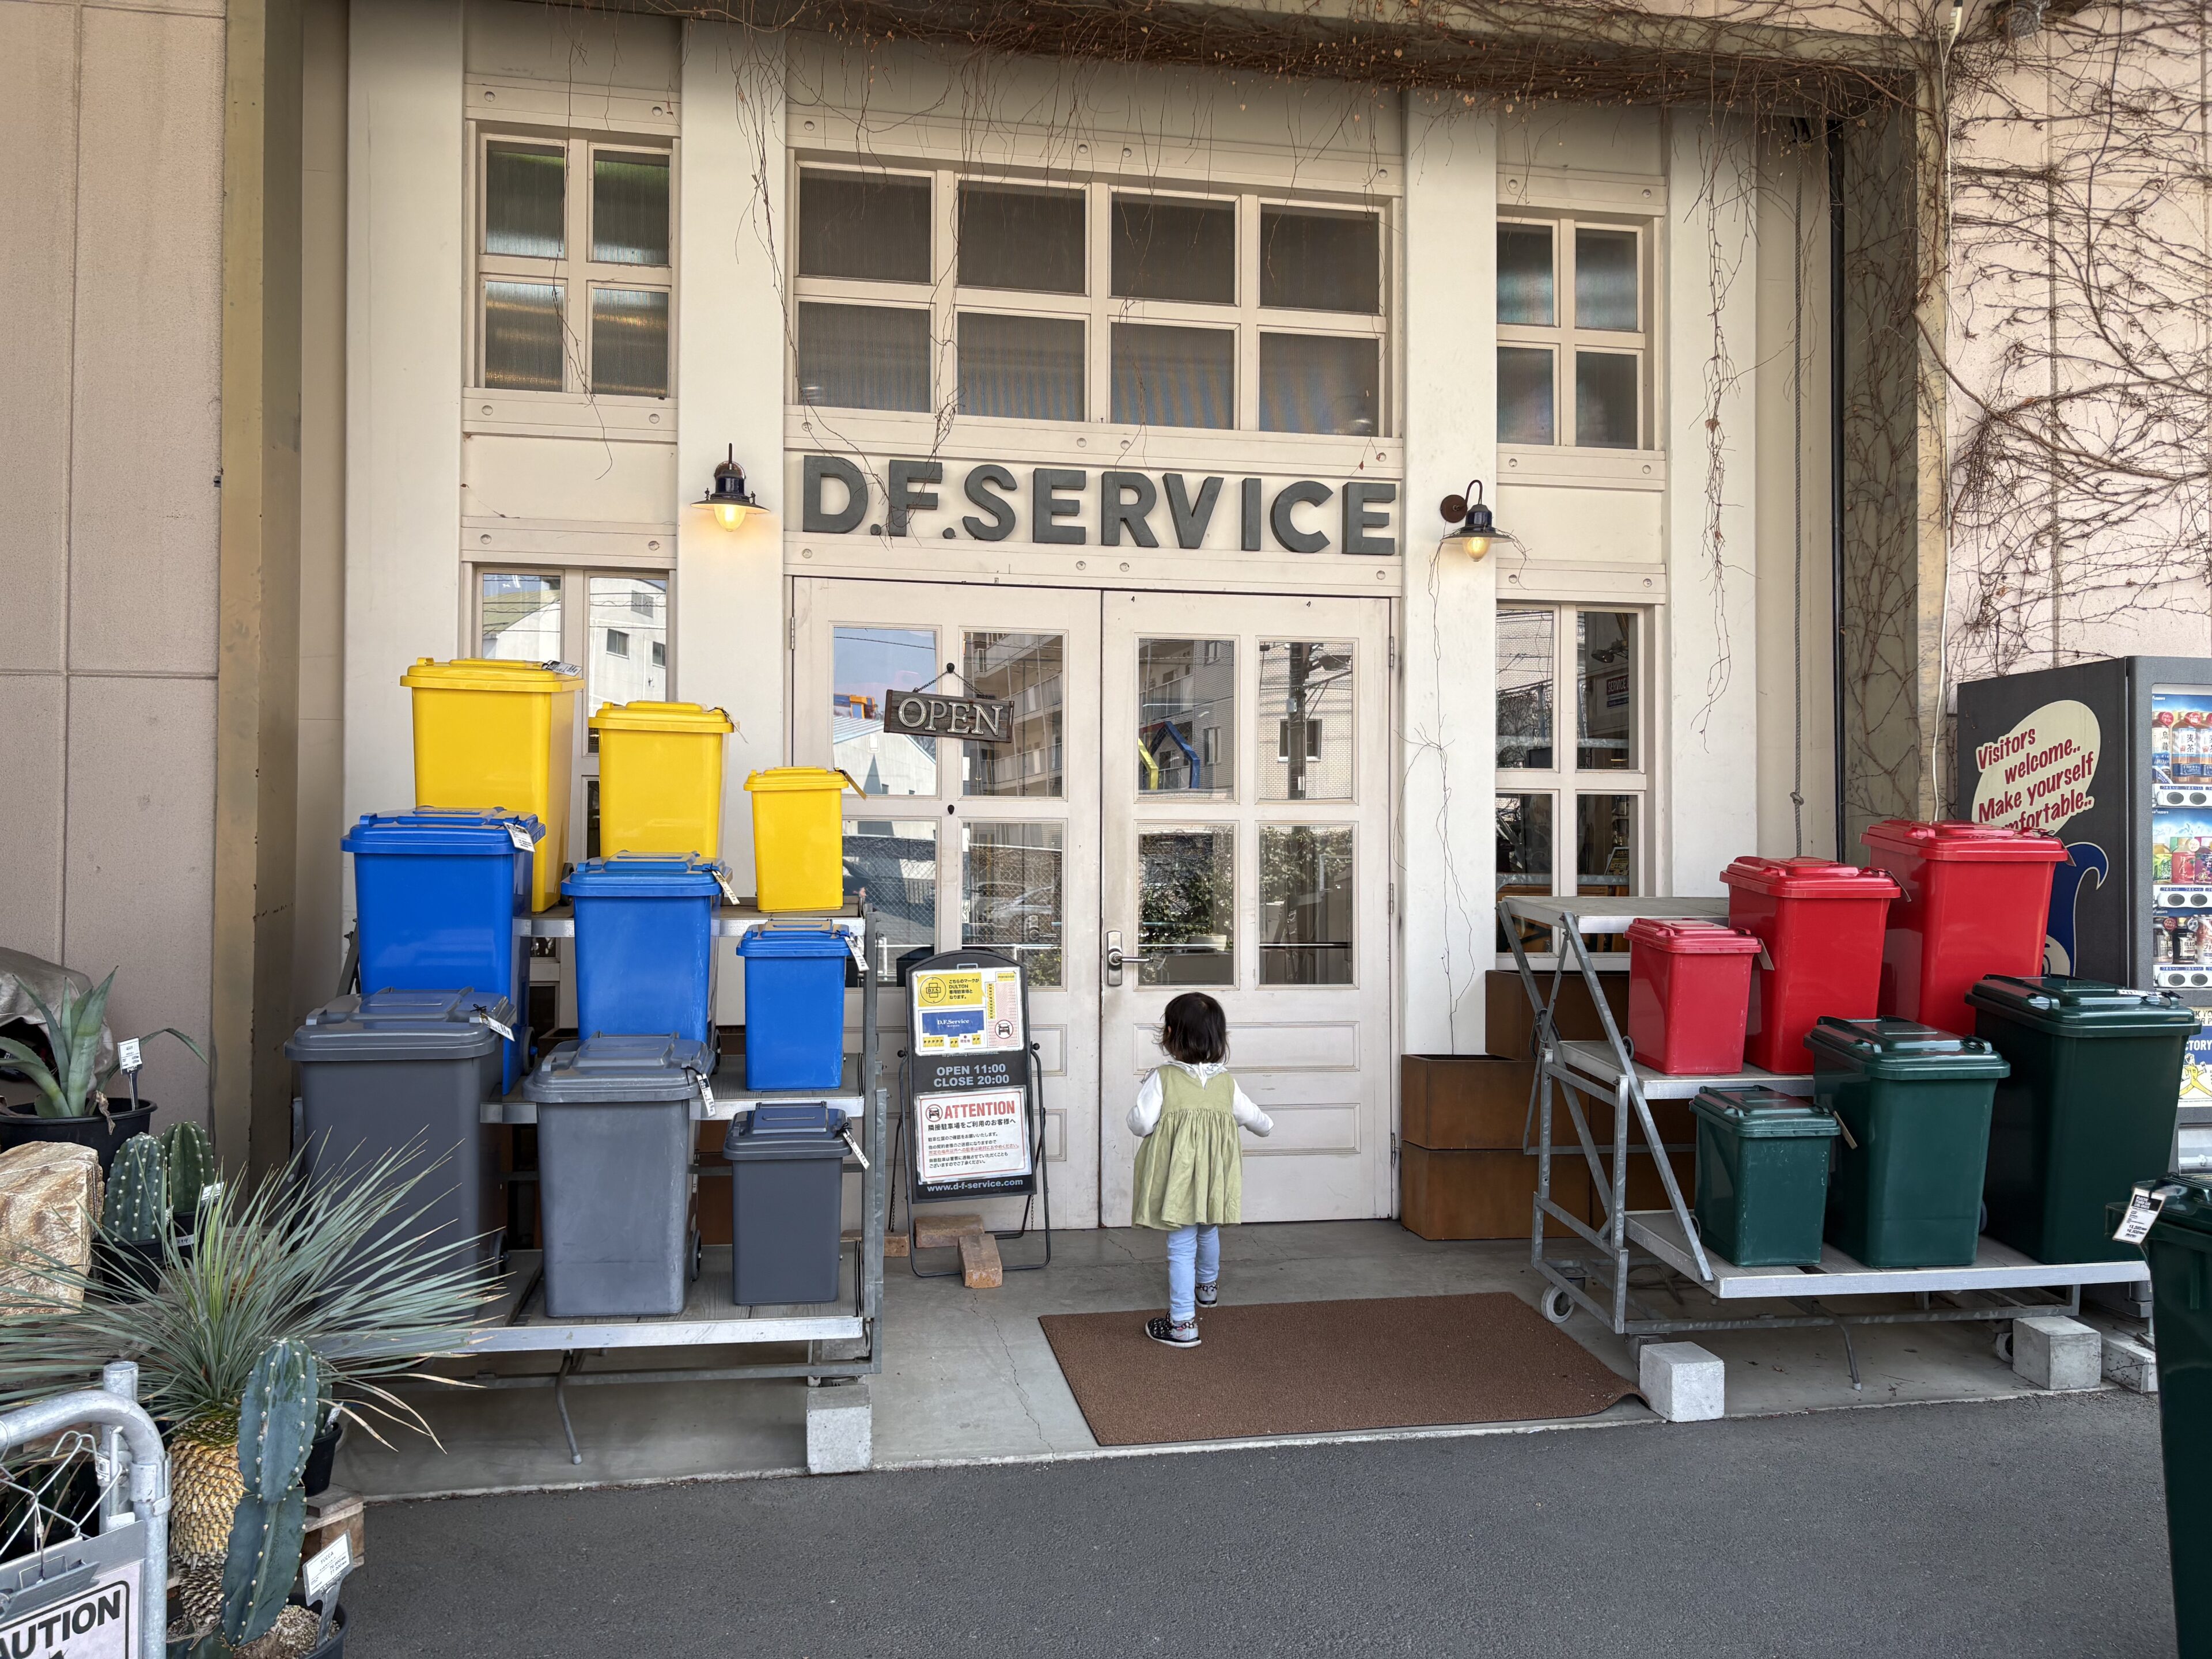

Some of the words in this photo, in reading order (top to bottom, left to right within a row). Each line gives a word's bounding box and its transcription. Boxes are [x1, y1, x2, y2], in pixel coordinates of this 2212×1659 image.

[802, 454, 1396, 555] D.F.SERVICE
[897, 696, 1003, 736] OPEN
[1978, 728, 2036, 770] Visitors
[2187, 734, 2194, 752] 麦茶
[2005, 738, 2081, 785] welcome..
[1978, 791, 2022, 823] Make
[2027, 751, 2094, 806] yourself
[2002, 789, 2092, 830] mfortable..
[934, 1076, 974, 1088] CLOSE
[977, 1074, 1009, 1085] 20:00
[937, 1066, 970, 1076] OPEN
[974, 1063, 1006, 1074] 11:00
[944, 1100, 1015, 1119] ATTENTION
[928, 1118, 1016, 1132] 隣接駐車場をご利用のお客様へ
[927, 1179, 1023, 1192] www.d-f-service.com
